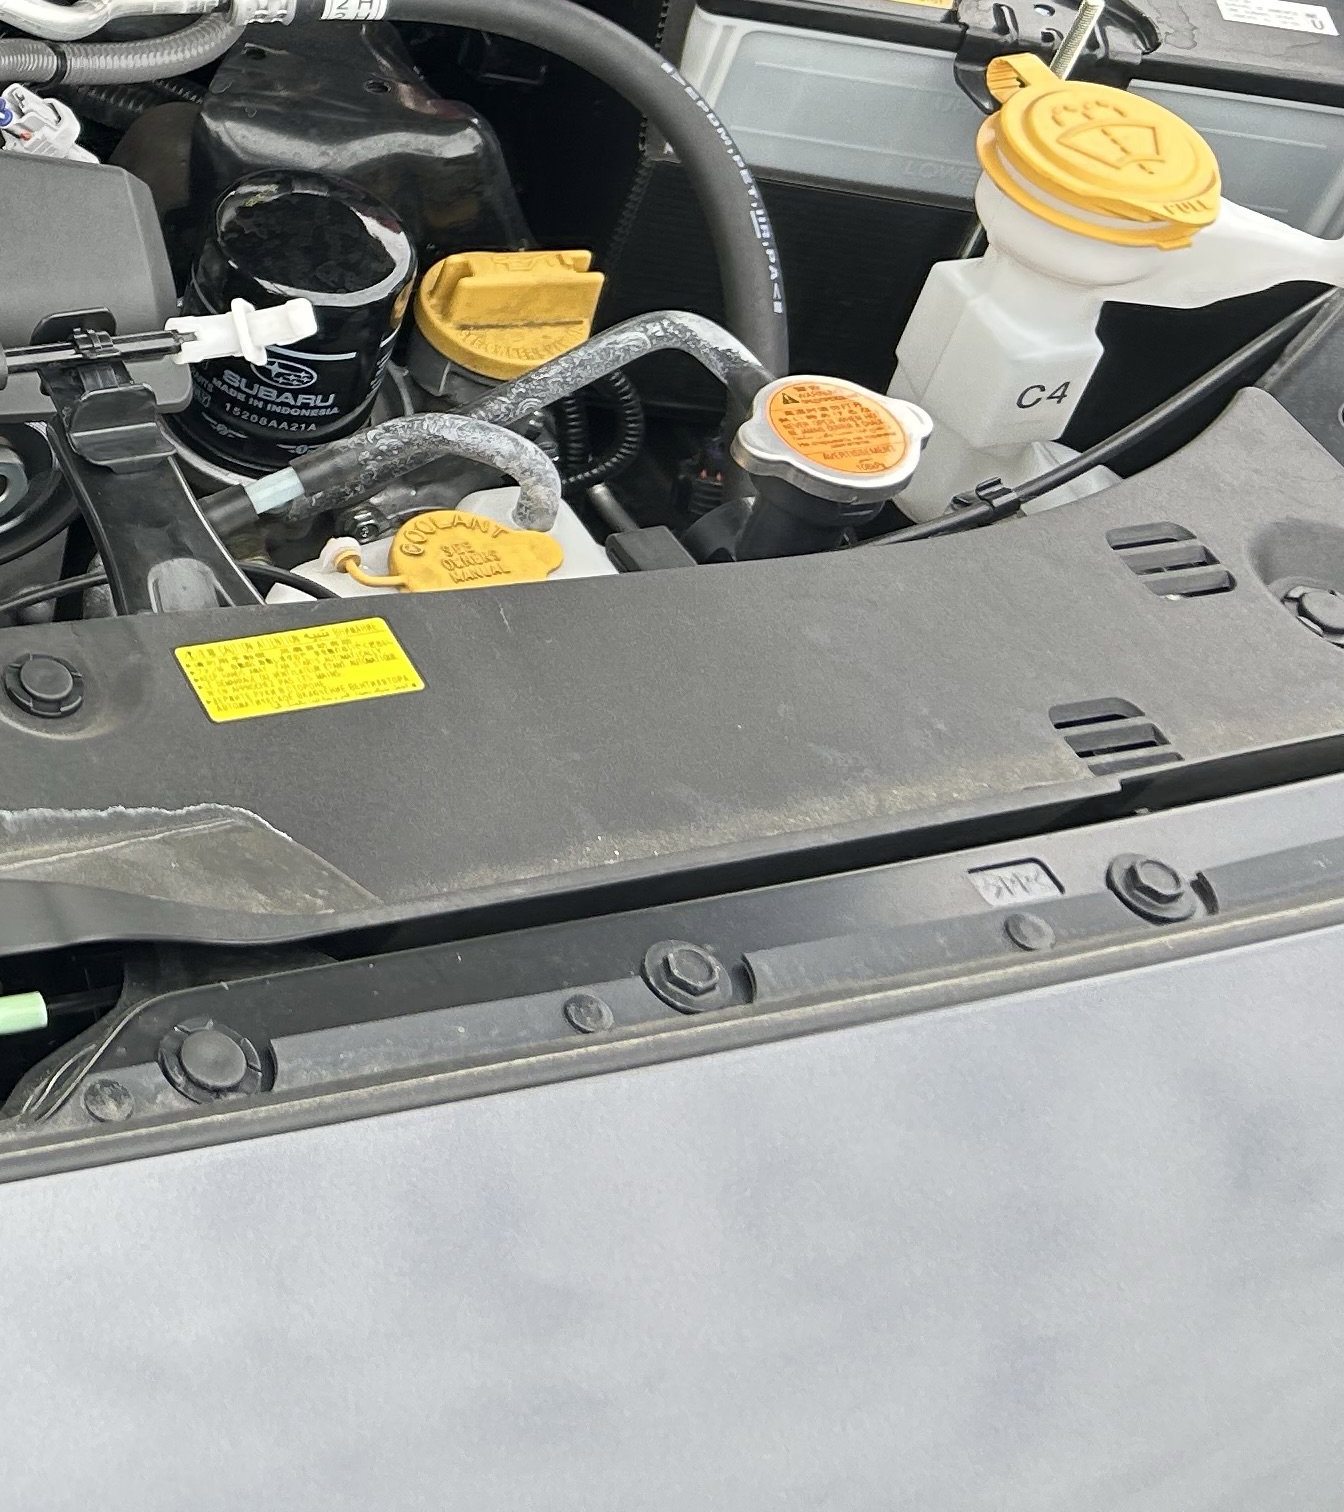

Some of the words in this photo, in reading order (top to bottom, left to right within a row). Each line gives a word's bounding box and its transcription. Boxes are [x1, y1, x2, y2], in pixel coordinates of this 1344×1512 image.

[212, 377, 247, 402] MADE
[248, 397, 264, 409] IN
[266, 402, 341, 418] INDONESIA
[222, 368, 336, 407] SUBARU
[1015, 380, 1071, 409] C4
[399, 513, 511, 558] COOLANT
[439, 540, 475, 558] SEE
[448, 563, 512, 585] MANUAL
